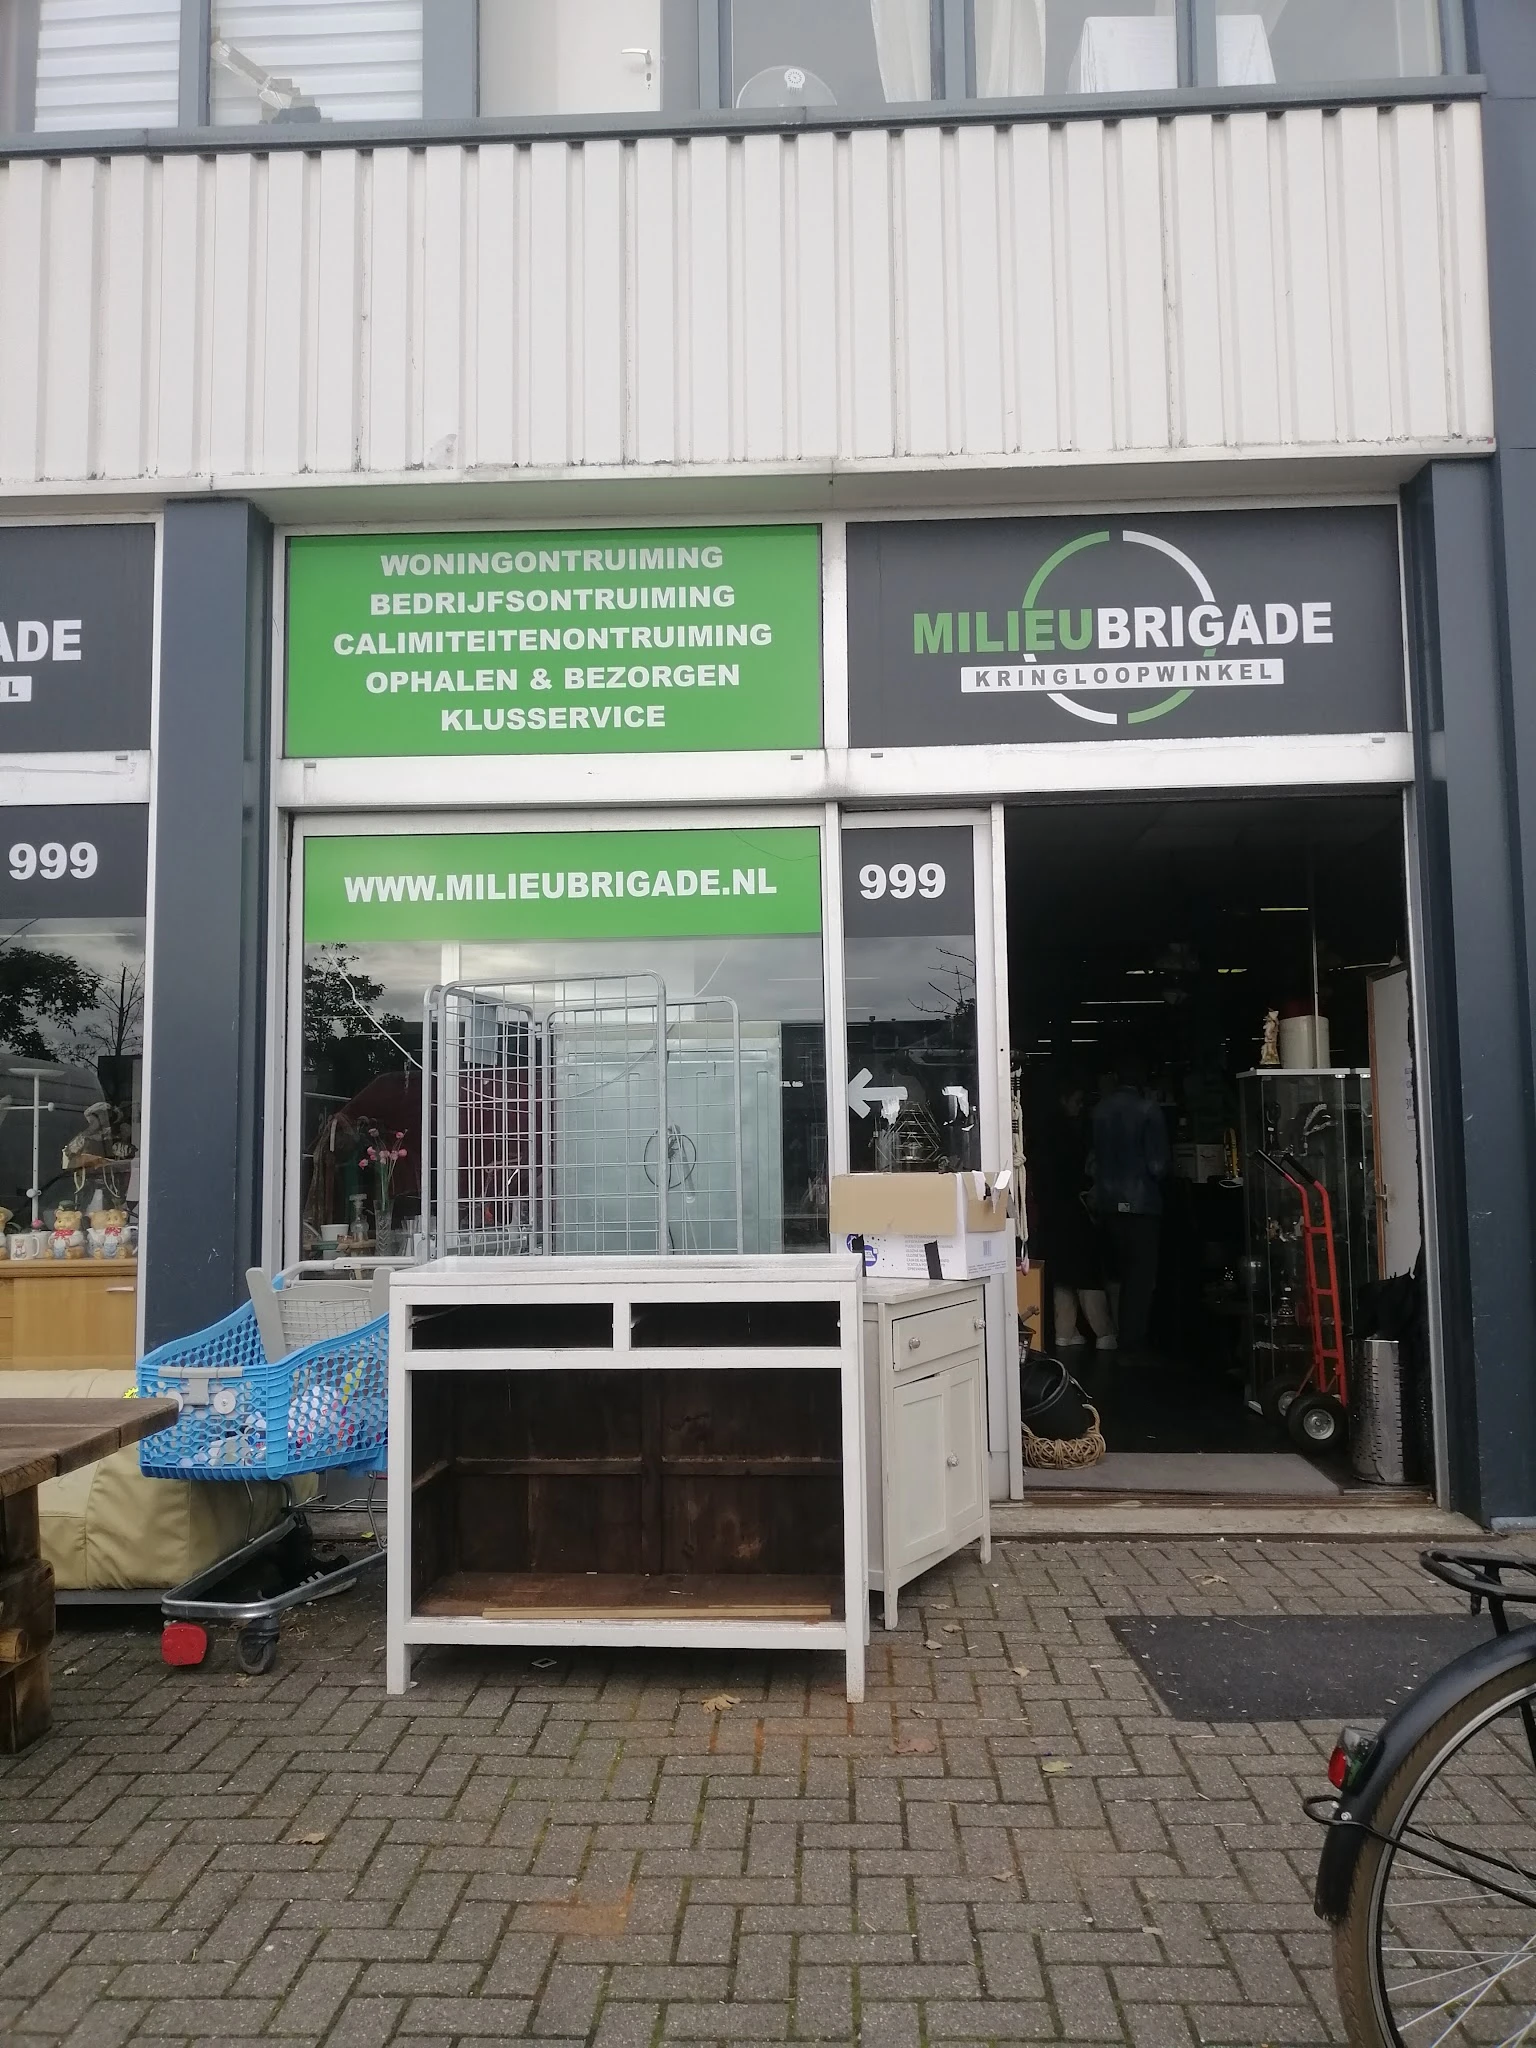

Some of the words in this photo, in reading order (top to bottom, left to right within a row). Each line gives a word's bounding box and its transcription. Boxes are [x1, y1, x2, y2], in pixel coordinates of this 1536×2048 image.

[381, 547, 723, 576] WONINGONTRUIMING
[371, 585, 734, 615] BEDRIJFSONTRUIMING
[334, 624, 773, 655] CALIMITEITENONTRUIMING
[913, 602, 1334, 654] MILIEUBRIGADE
[366, 668, 518, 694] OPHALEN
[529, 667, 553, 691] &
[565, 664, 740, 689] BEZORGEN
[975, 663, 1272, 688] KRINGLOOPWINKEL
[442, 705, 666, 731] KLUSSERVICE
[8, 842, 98, 880] 999
[344, 868, 778, 904] WWW.MILIEUBRIGADE.NL
[858, 863, 946, 899] 999
